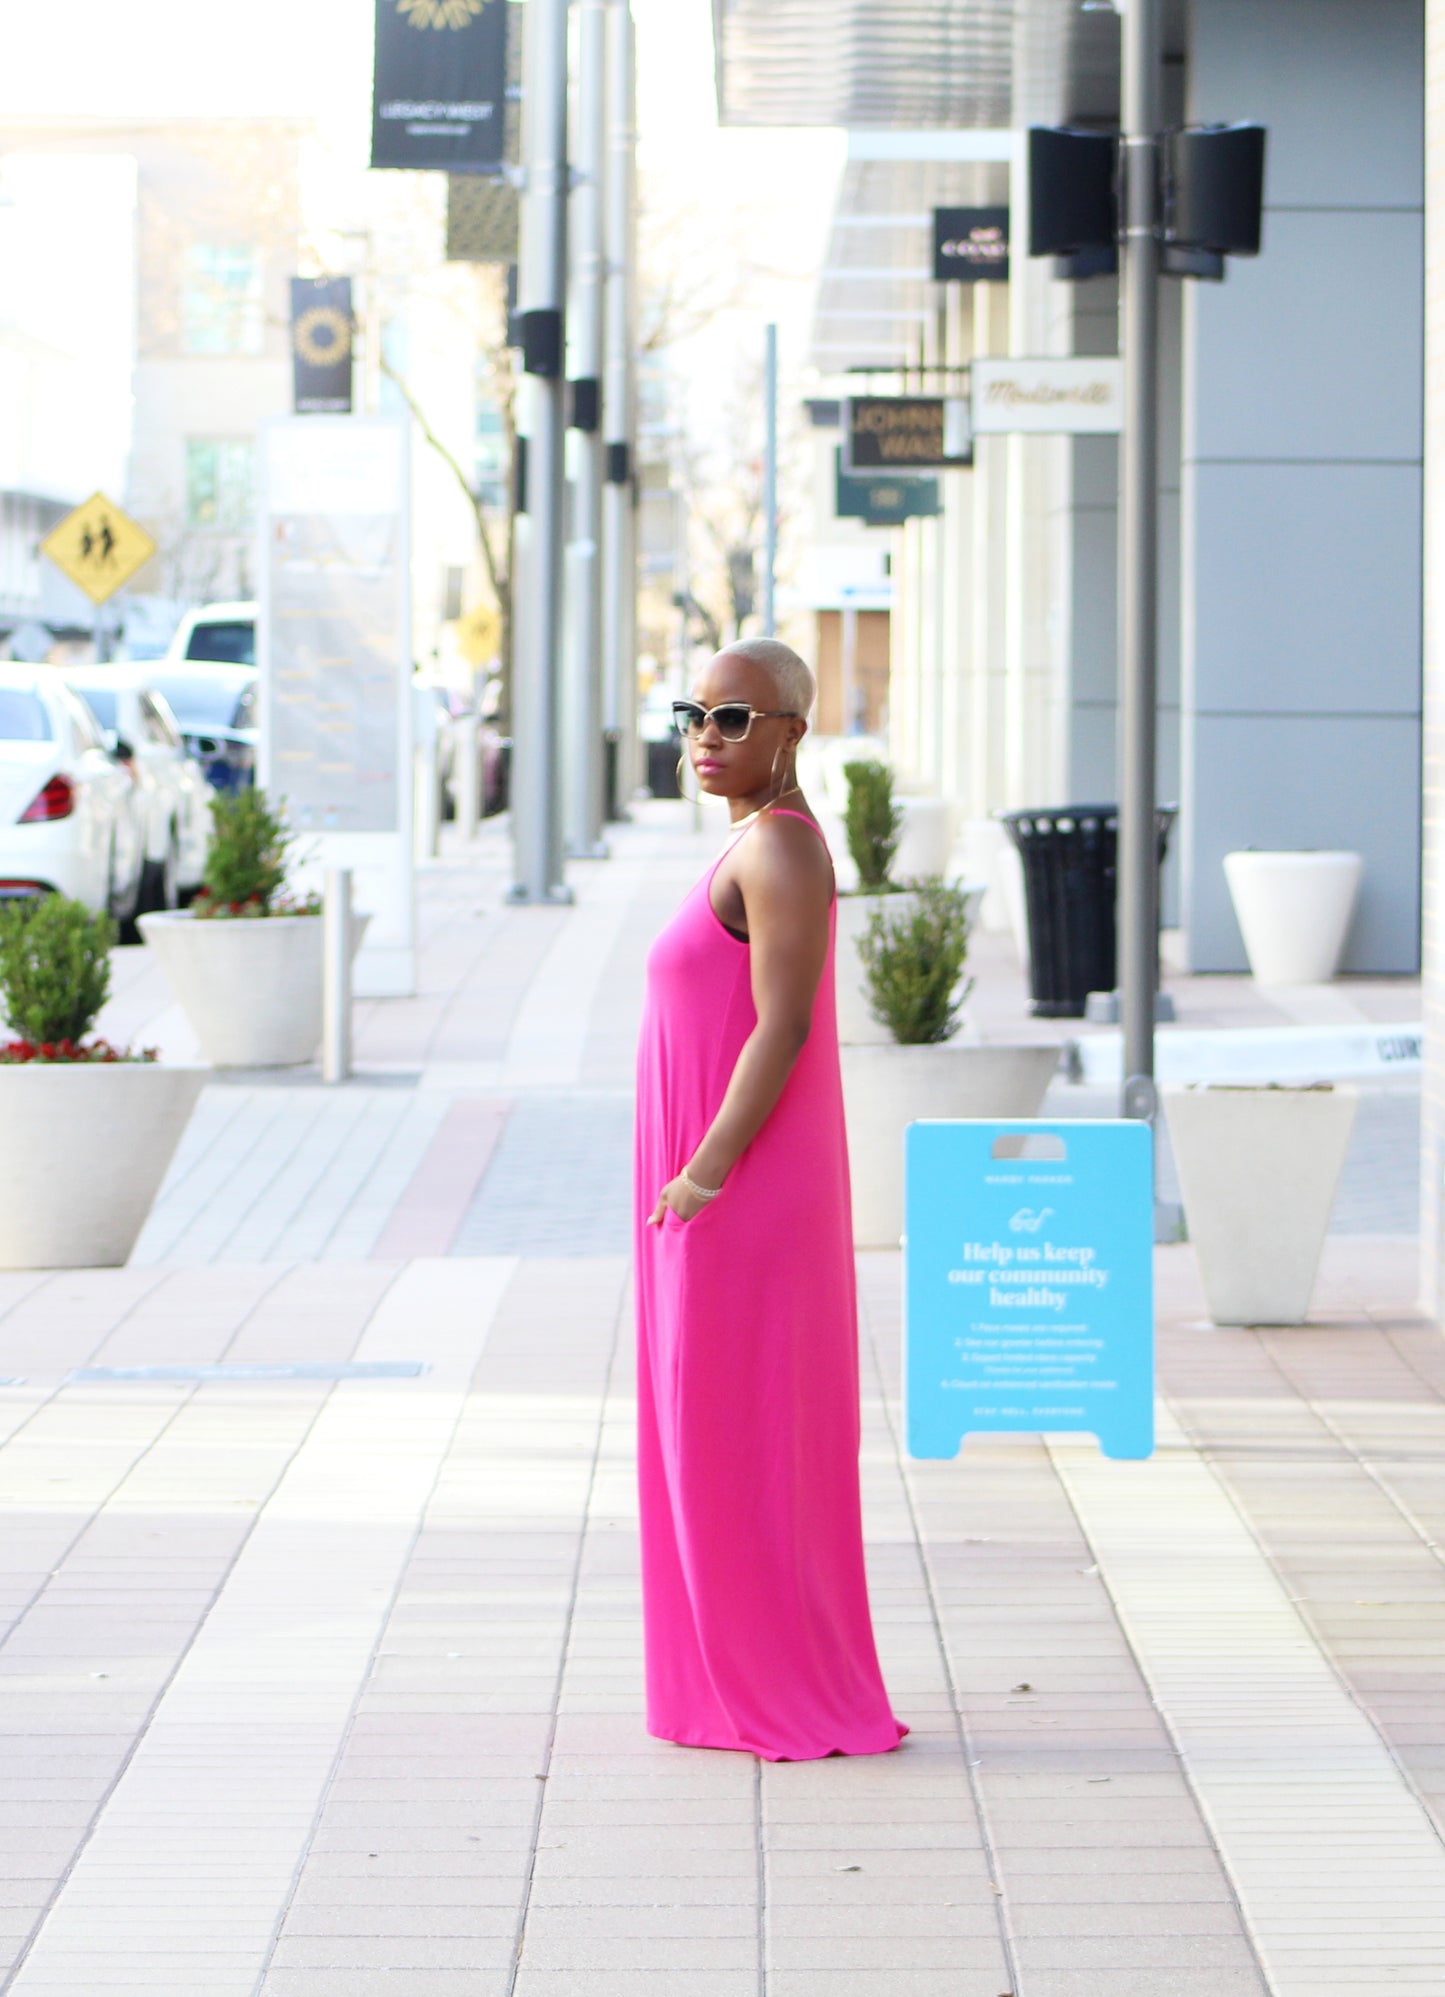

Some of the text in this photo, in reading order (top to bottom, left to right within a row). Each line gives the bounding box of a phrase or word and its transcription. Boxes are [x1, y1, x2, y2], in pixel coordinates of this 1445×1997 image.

[855, 405, 943, 432] JOHNN
[963, 1241, 1095, 1266] Help us keep
[947, 1266, 1110, 1289] our community
[990, 1287, 1069, 1313] healthy
